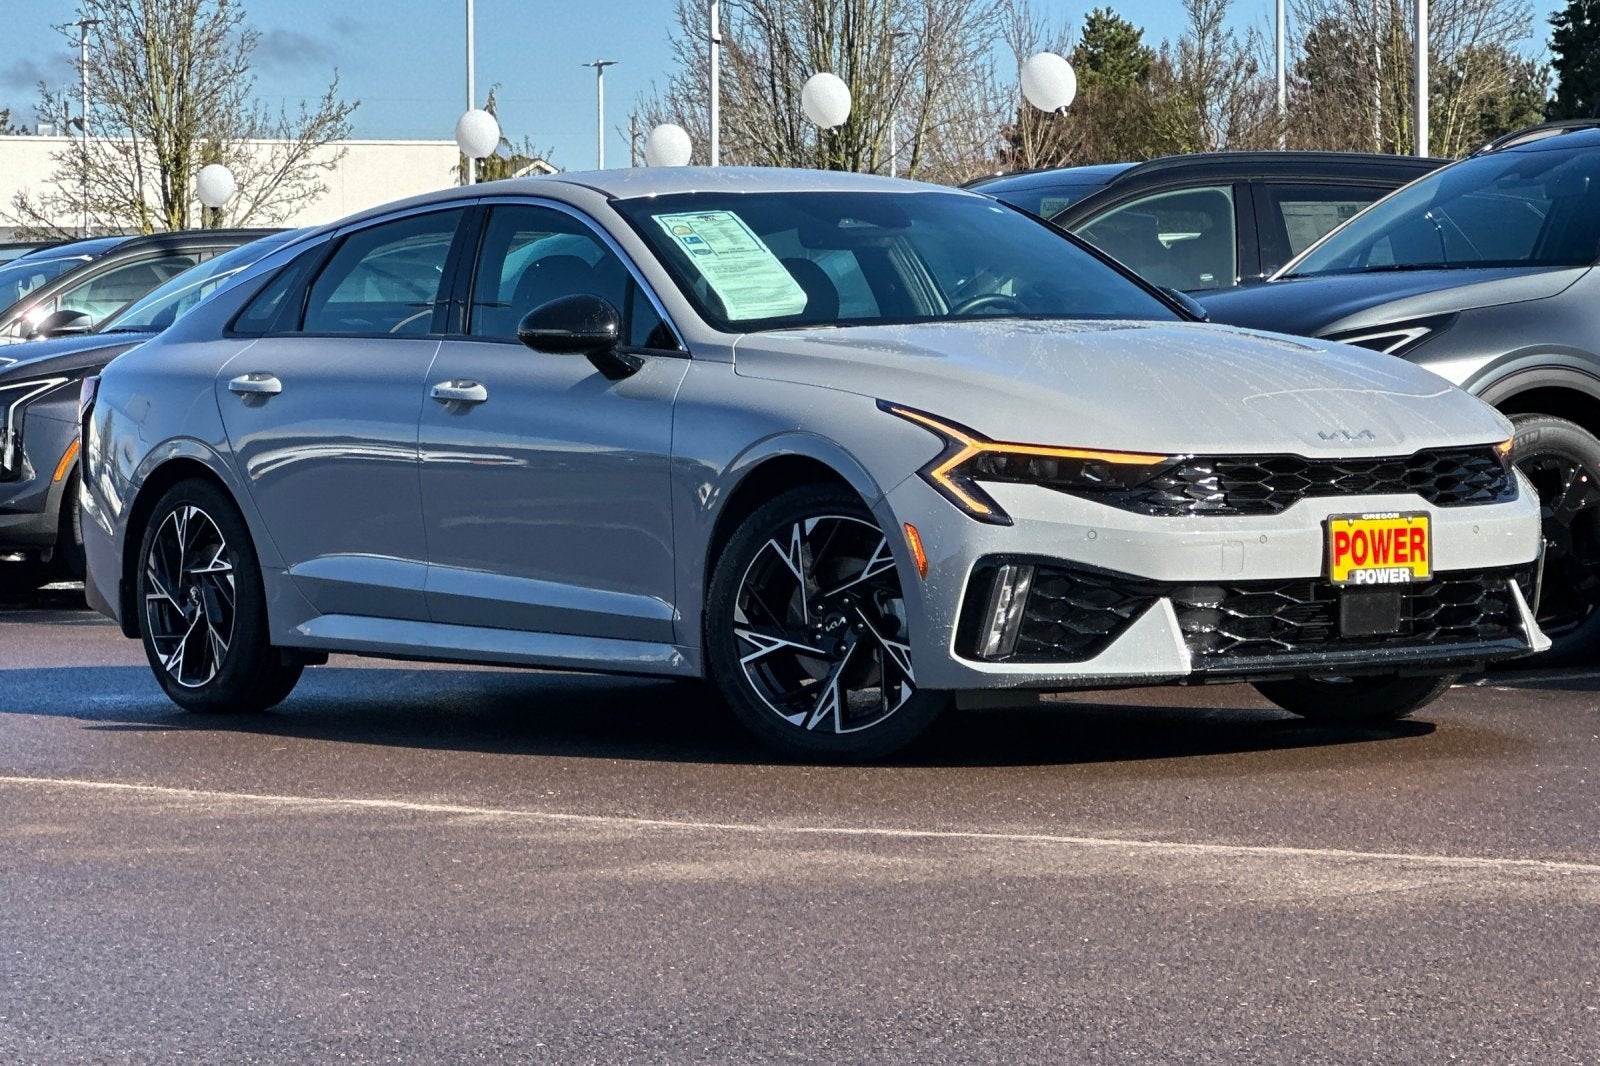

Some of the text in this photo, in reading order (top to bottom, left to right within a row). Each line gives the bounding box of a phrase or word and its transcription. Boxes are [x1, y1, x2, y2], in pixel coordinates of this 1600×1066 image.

[1362, 512, 1400, 520] OREGON
[1334, 527, 1426, 567] POWER
[1355, 567, 1411, 585] POWER
